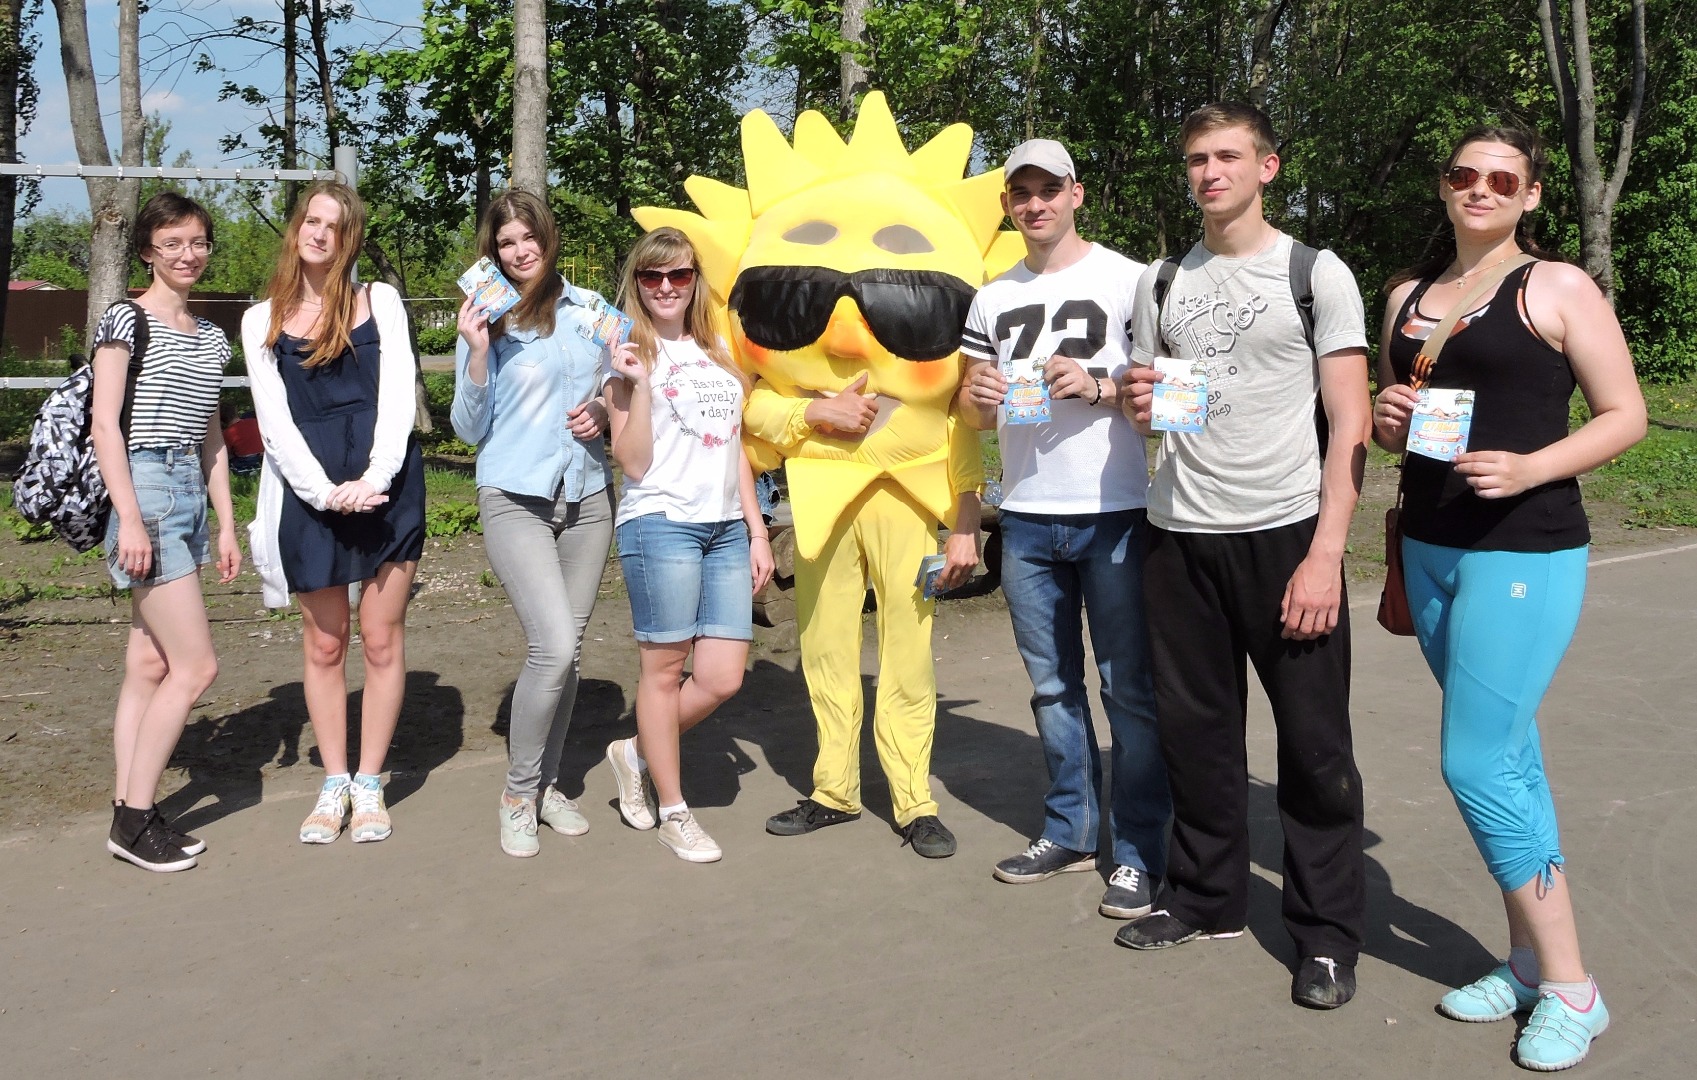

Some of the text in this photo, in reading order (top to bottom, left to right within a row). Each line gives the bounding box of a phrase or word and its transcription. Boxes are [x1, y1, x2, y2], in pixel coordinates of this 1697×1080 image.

[995, 299, 1109, 402] 72
[690, 379, 736, 389] Have a
[696, 390, 738, 405] lovely
[708, 406, 729, 421] day
